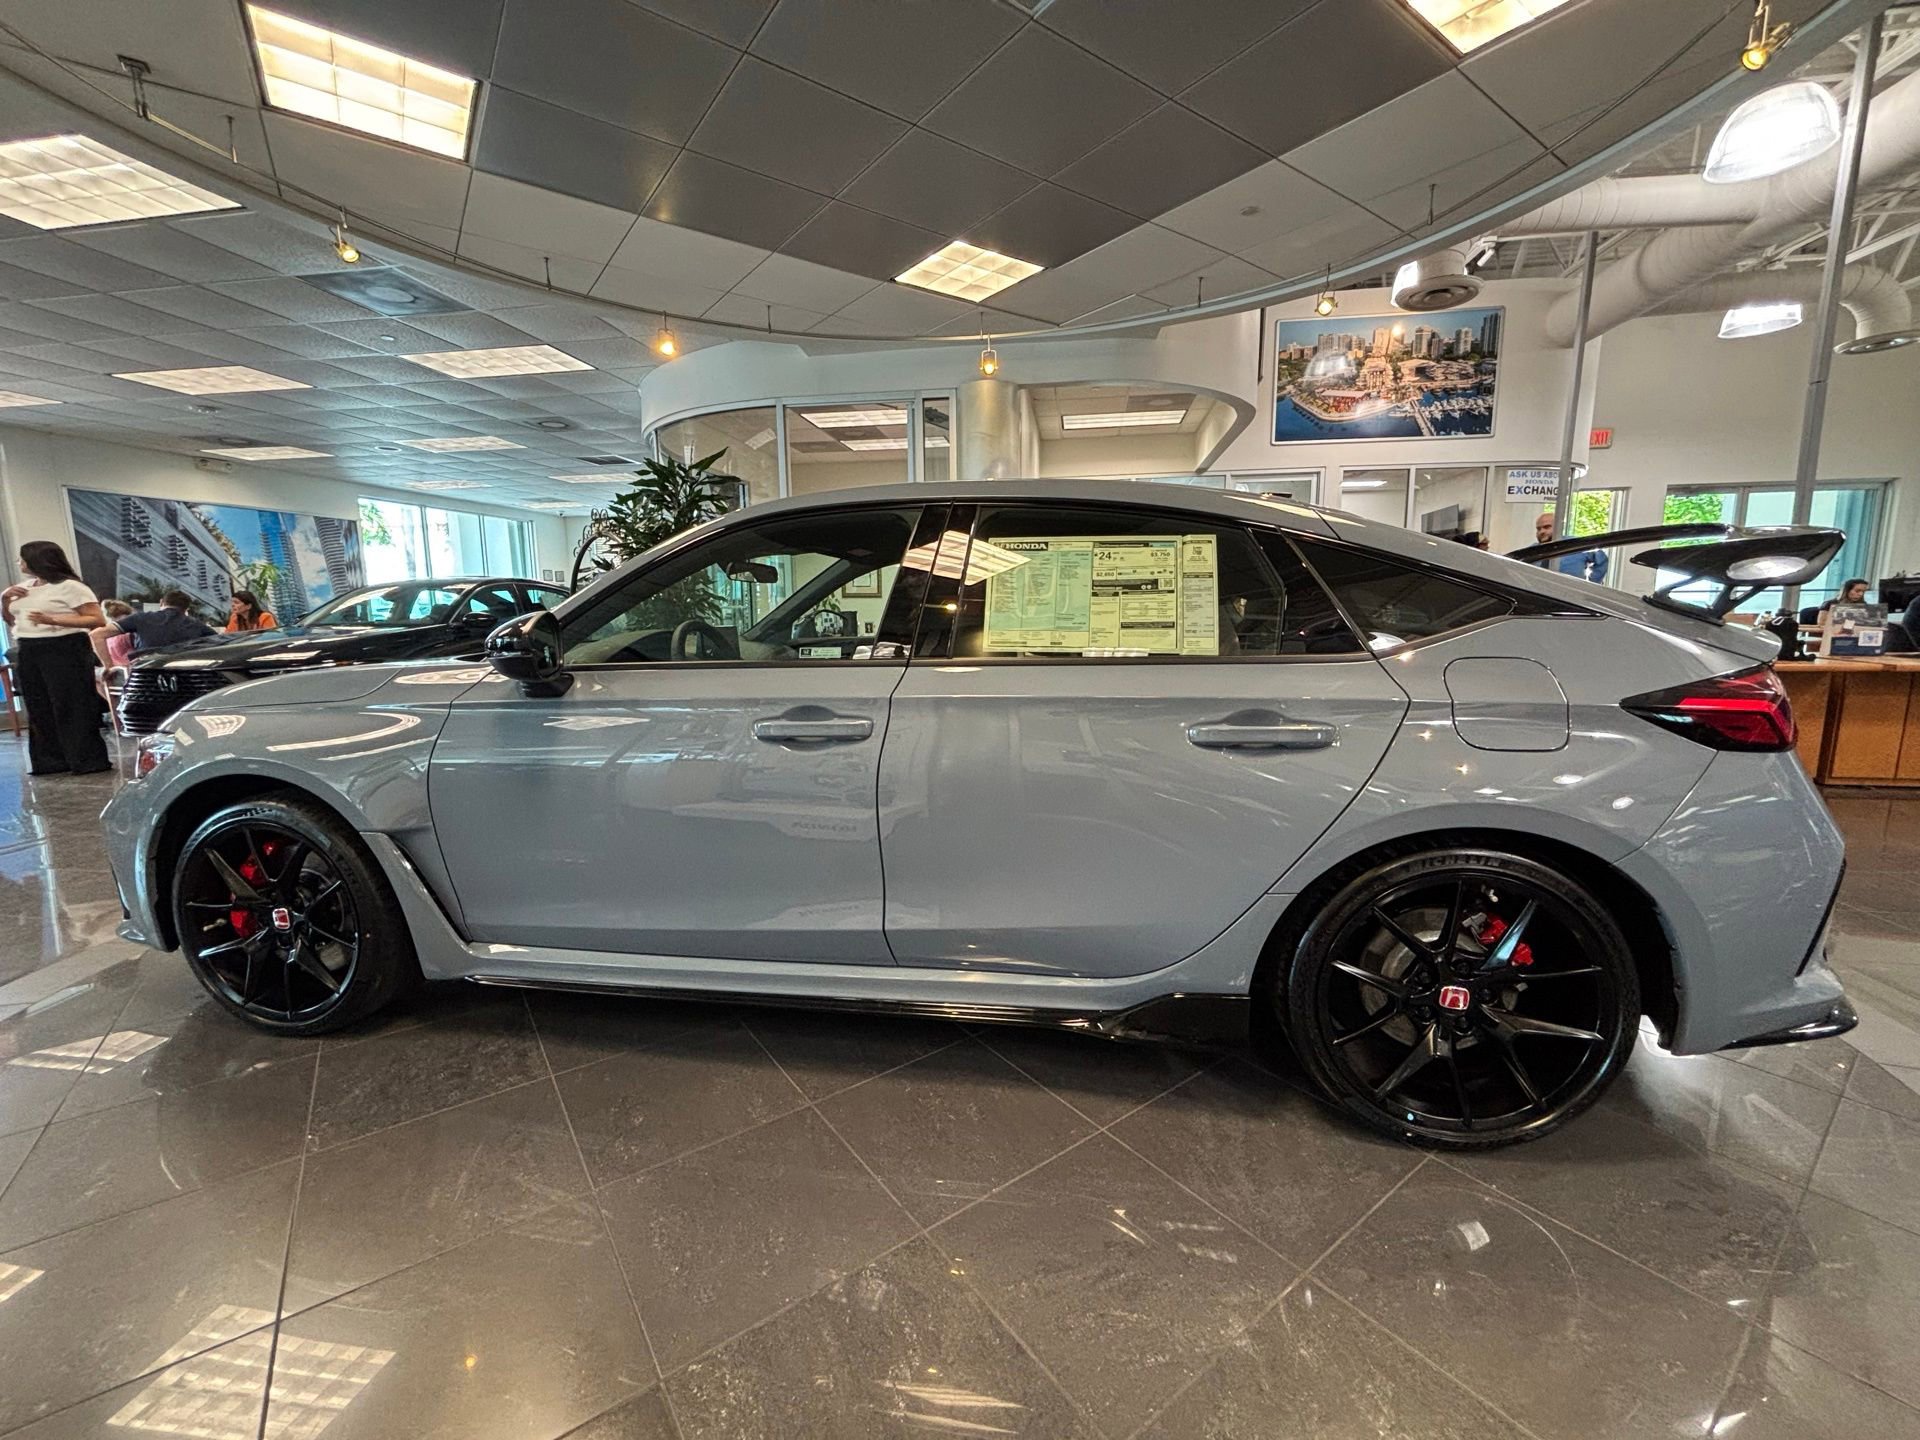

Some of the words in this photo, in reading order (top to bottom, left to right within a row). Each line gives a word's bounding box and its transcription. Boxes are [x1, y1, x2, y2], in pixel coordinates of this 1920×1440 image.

[1543, 471, 1559, 479] ABO
[1507, 485, 1559, 496] EXCHANG
[1099, 551, 1112, 560] 24
[1409, 855, 1501, 871] MICHELIN
